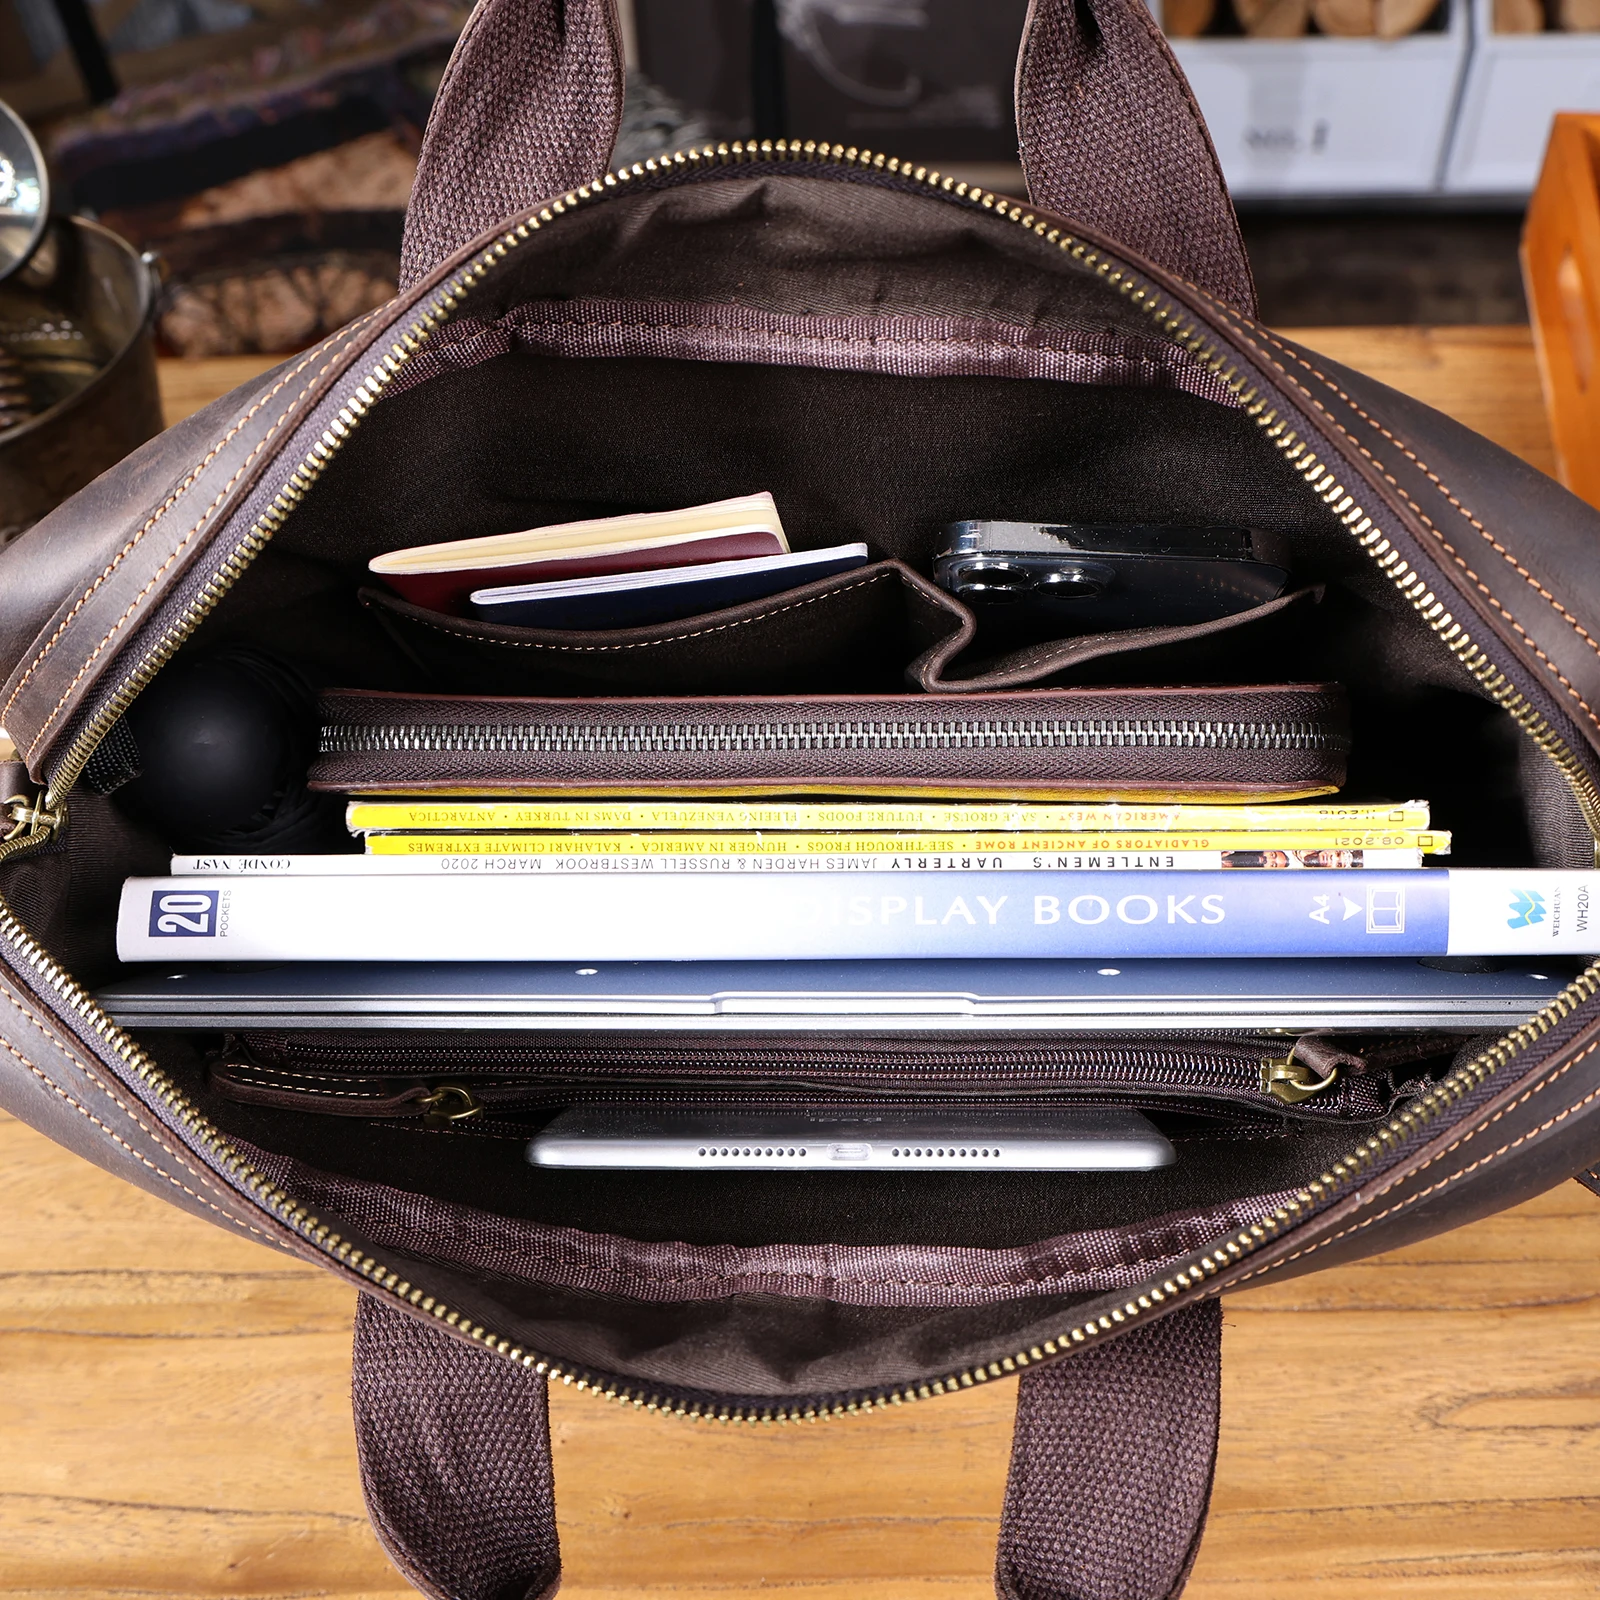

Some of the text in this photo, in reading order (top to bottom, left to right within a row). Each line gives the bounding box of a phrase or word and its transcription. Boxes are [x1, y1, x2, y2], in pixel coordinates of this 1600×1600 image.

[408, 811, 496, 823] ANTARCTICA
[515, 811, 570, 822] TURKEY
[575, 811, 589, 822] IN
[593, 811, 631, 822] DAMS
[652, 811, 734, 822] VENEZUELA
[739, 811, 797, 822] FLEEING
[818, 811, 862, 822] FOODS
[867, 811, 922, 822] FUTURE
[944, 811, 997, 823] GROUSE
[1058, 811, 1096, 822] WEST
[407, 838, 1209, 853] GLADIATORS OF ANCIENT ROME SEE-THROUGH FROGS HUNGER IN AMERICA KALAHARI CLIMATE EXTREMES
[1334, 836, 1404, 847] 08.2021
[192, 858, 291, 872] CONDÉ NAST
[440, 858, 478, 870] 2020
[484, 858, 542, 870] MARCH
[555, 858, 653, 870] WESTBROOK
[659, 857, 730, 869] RUSSELL
[736, 857, 746, 869] &
[752, 858, 819, 869] HARDEN
[826, 857, 877, 869] JAMES
[891, 857, 1002, 869] UARTERLY
[157, 893, 213, 934] 20
[219, 890, 232, 938] POCKETS
[1034, 894, 1226, 925] BOOKS
[1308, 893, 1331, 925] A4
[1576, 884, 1589, 933] WH20A
